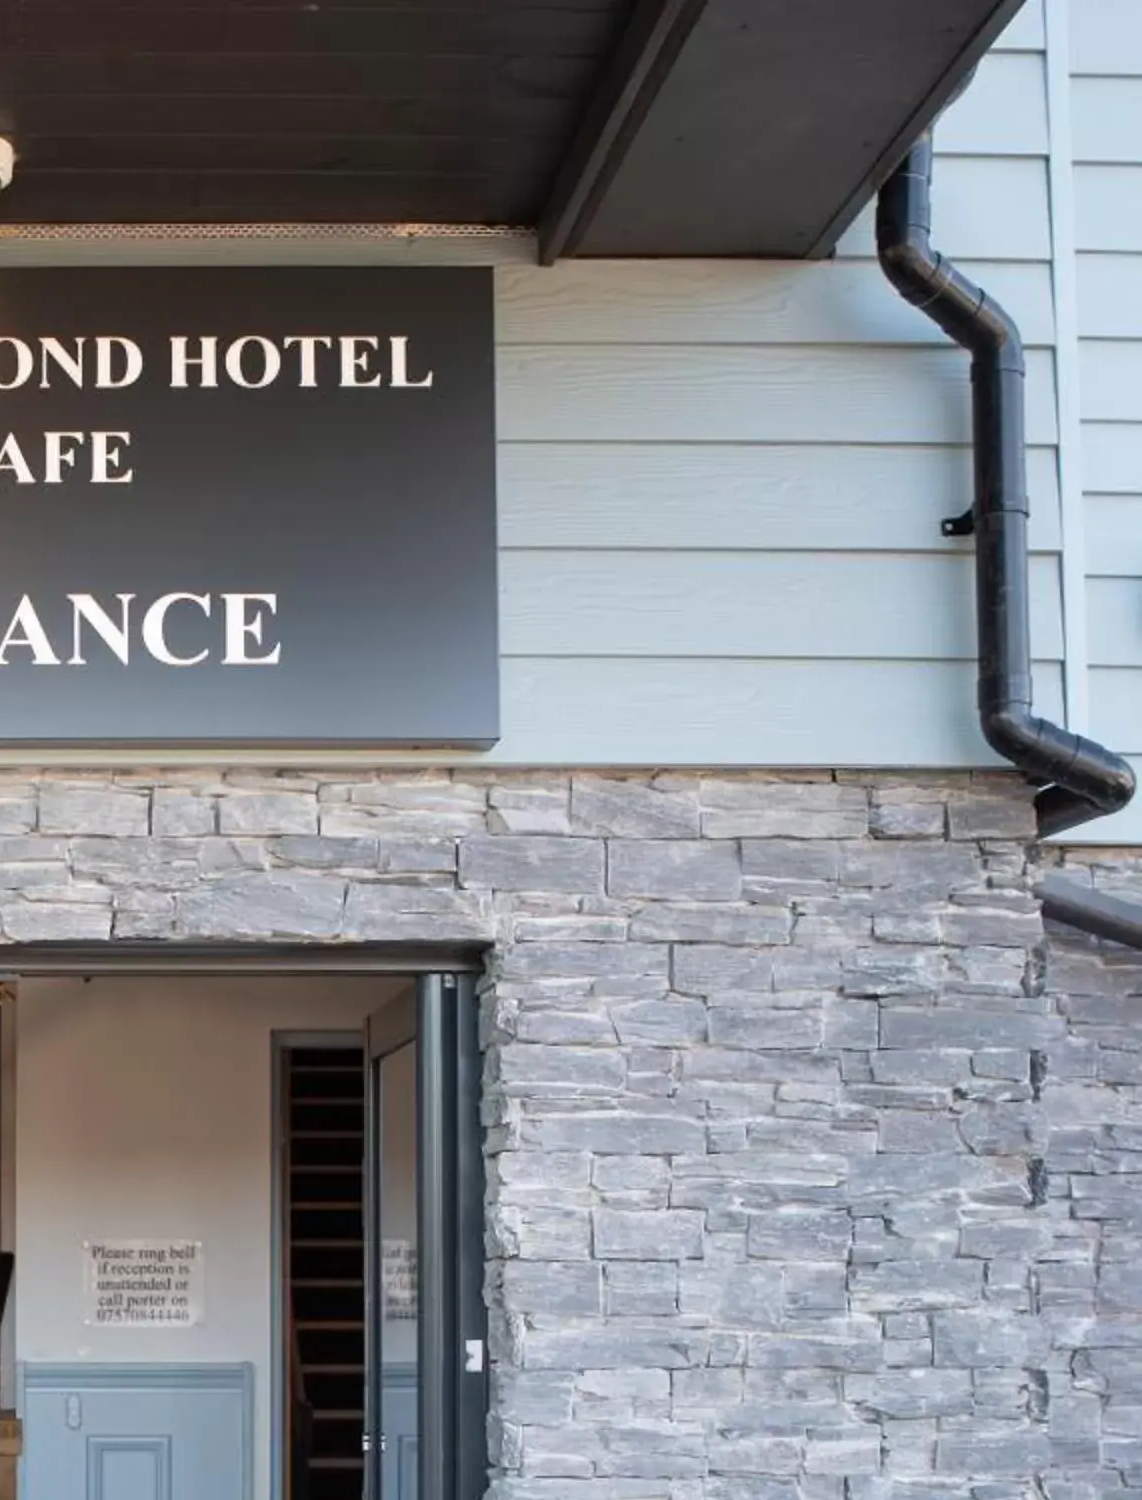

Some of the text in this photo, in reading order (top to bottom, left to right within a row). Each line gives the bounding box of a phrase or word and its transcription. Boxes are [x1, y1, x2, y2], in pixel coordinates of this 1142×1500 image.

[169, 336, 434, 389] HOTEL
[92, 1245, 196, 1262] Please ring bell
[98, 1262, 190, 1277] if reception is
[97, 1277, 189, 1291] unattended or
[98, 1293, 189, 1309] call porter on
